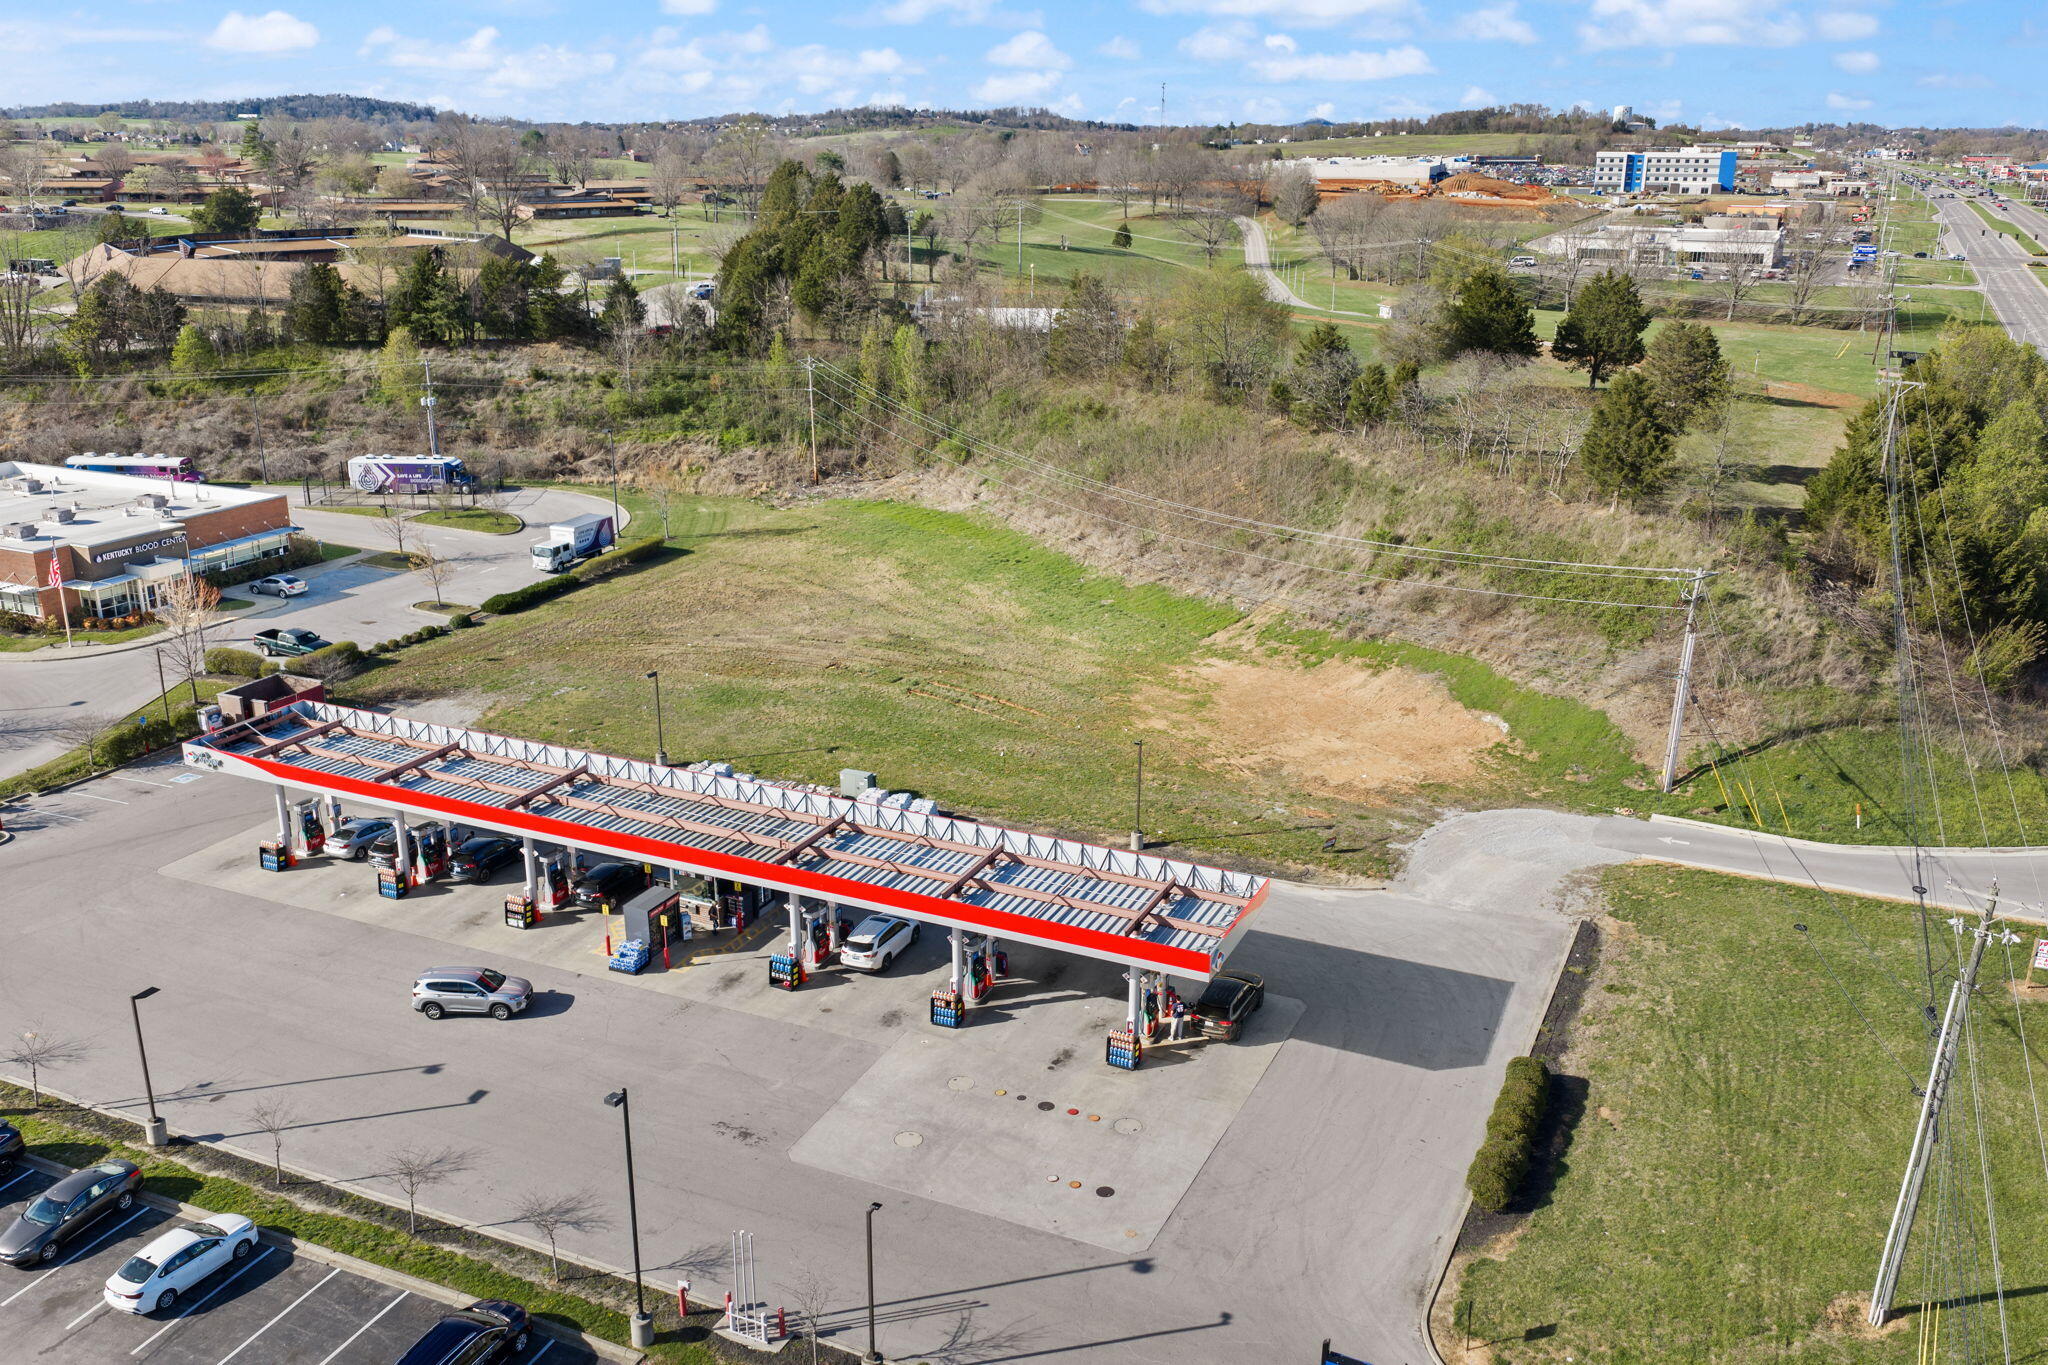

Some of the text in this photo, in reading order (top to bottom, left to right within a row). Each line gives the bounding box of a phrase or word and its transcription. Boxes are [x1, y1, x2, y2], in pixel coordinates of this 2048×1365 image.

[102, 535, 186, 561] KENTUCKY BLOOD CENTER
